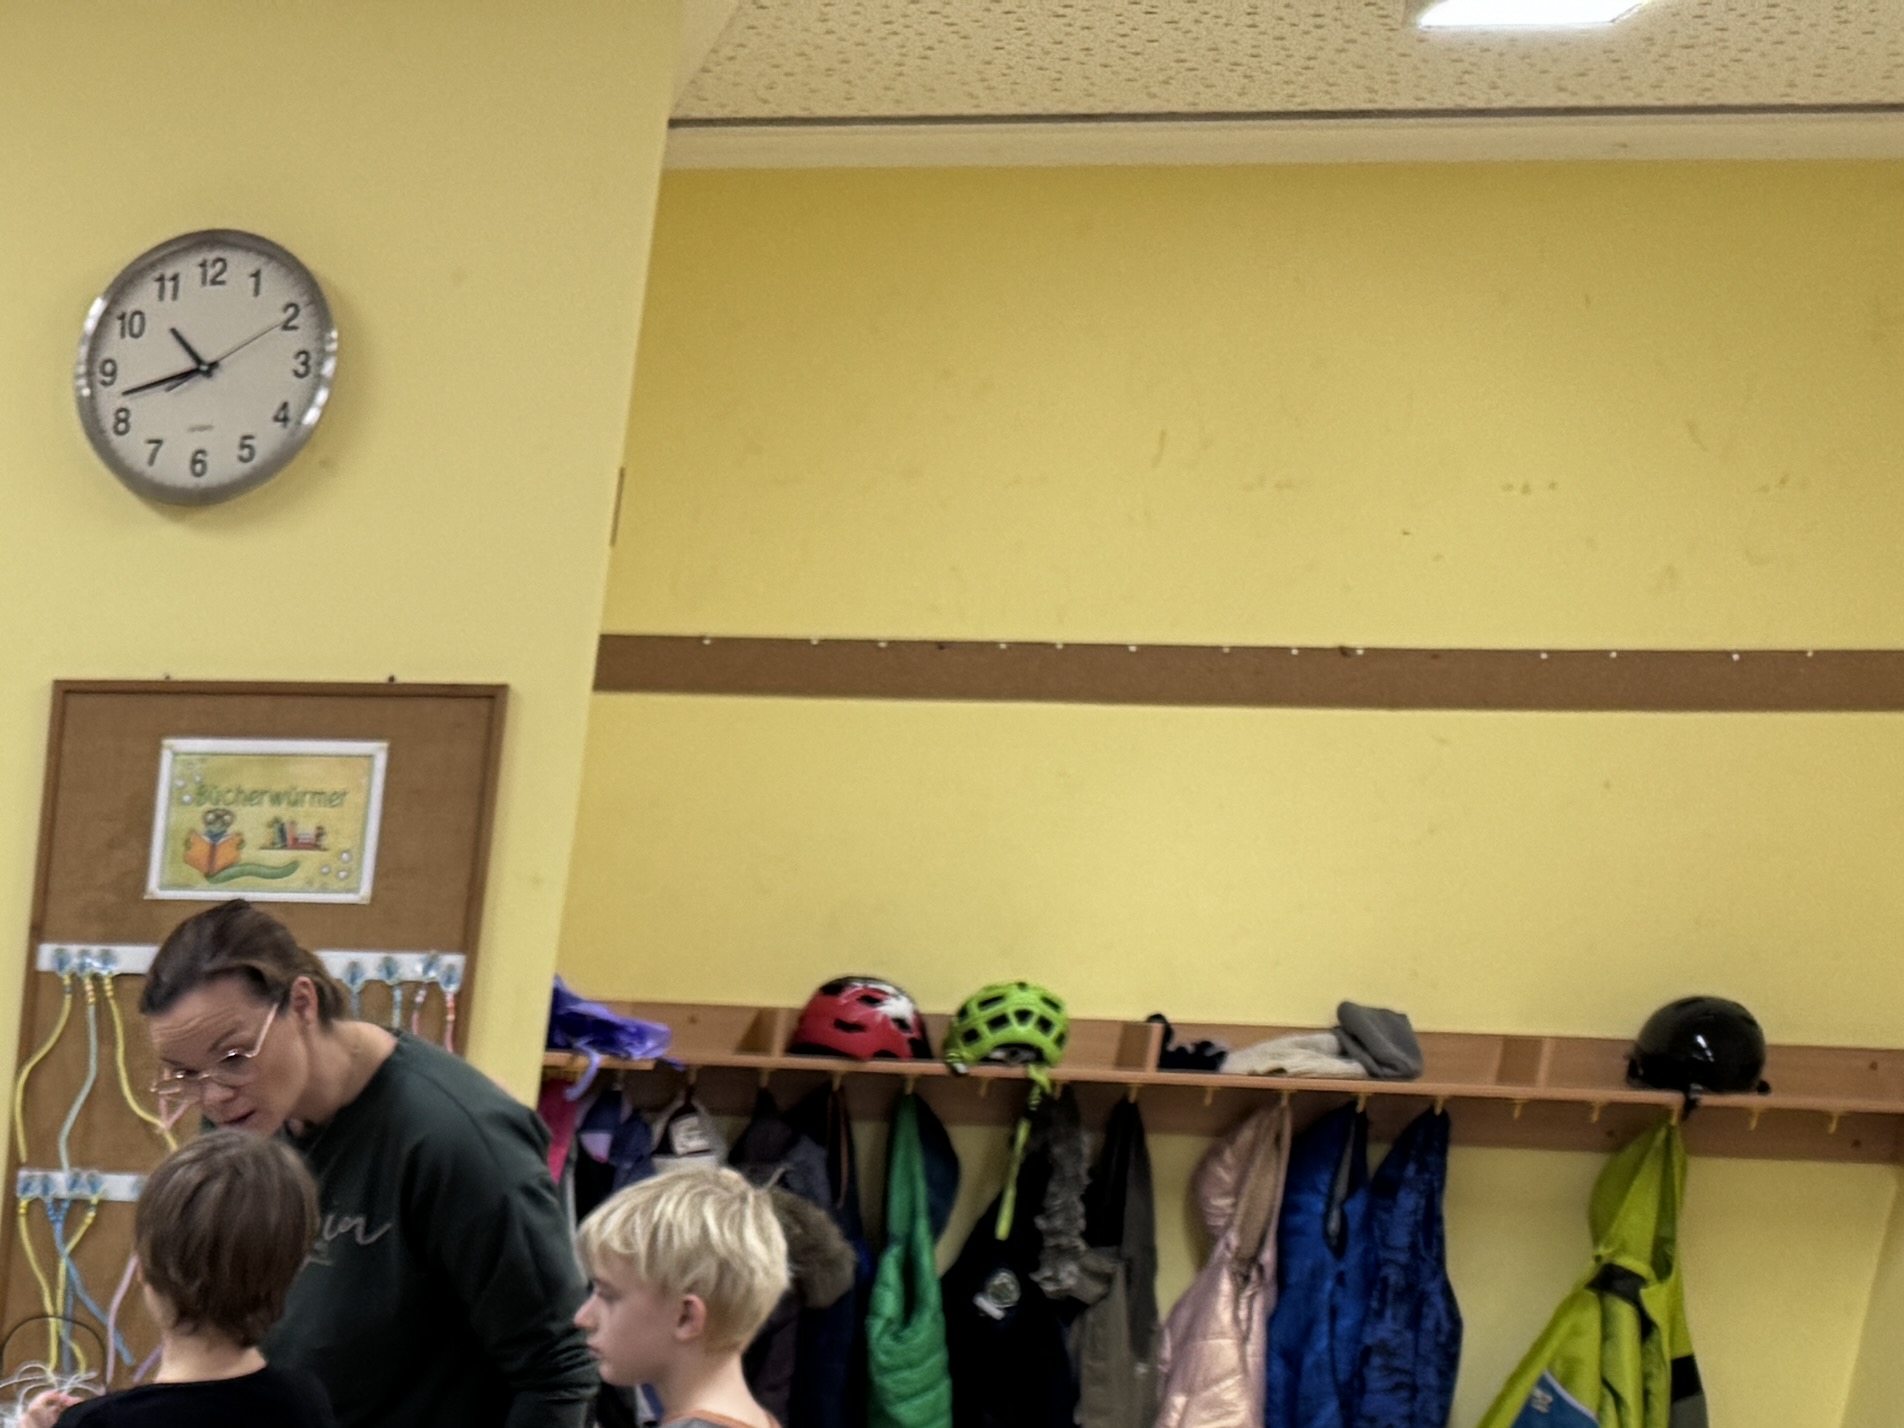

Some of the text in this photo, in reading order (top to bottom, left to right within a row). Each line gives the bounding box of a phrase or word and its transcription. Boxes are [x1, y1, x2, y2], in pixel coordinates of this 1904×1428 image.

[198, 258, 227, 286] 12
[249, 269, 262, 297] 1
[155, 273, 180, 301] 11
[117, 310, 146, 339] 10
[282, 302, 300, 332] 2
[99, 358, 117, 387] 9
[293, 350, 311, 379] 3
[113, 408, 131, 436] 8
[273, 401, 289, 427] 4
[145, 439, 163, 466] 7
[238, 435, 256, 463] 5
[190, 449, 207, 478] 6
[195, 783, 348, 808] Bücherwürmer
